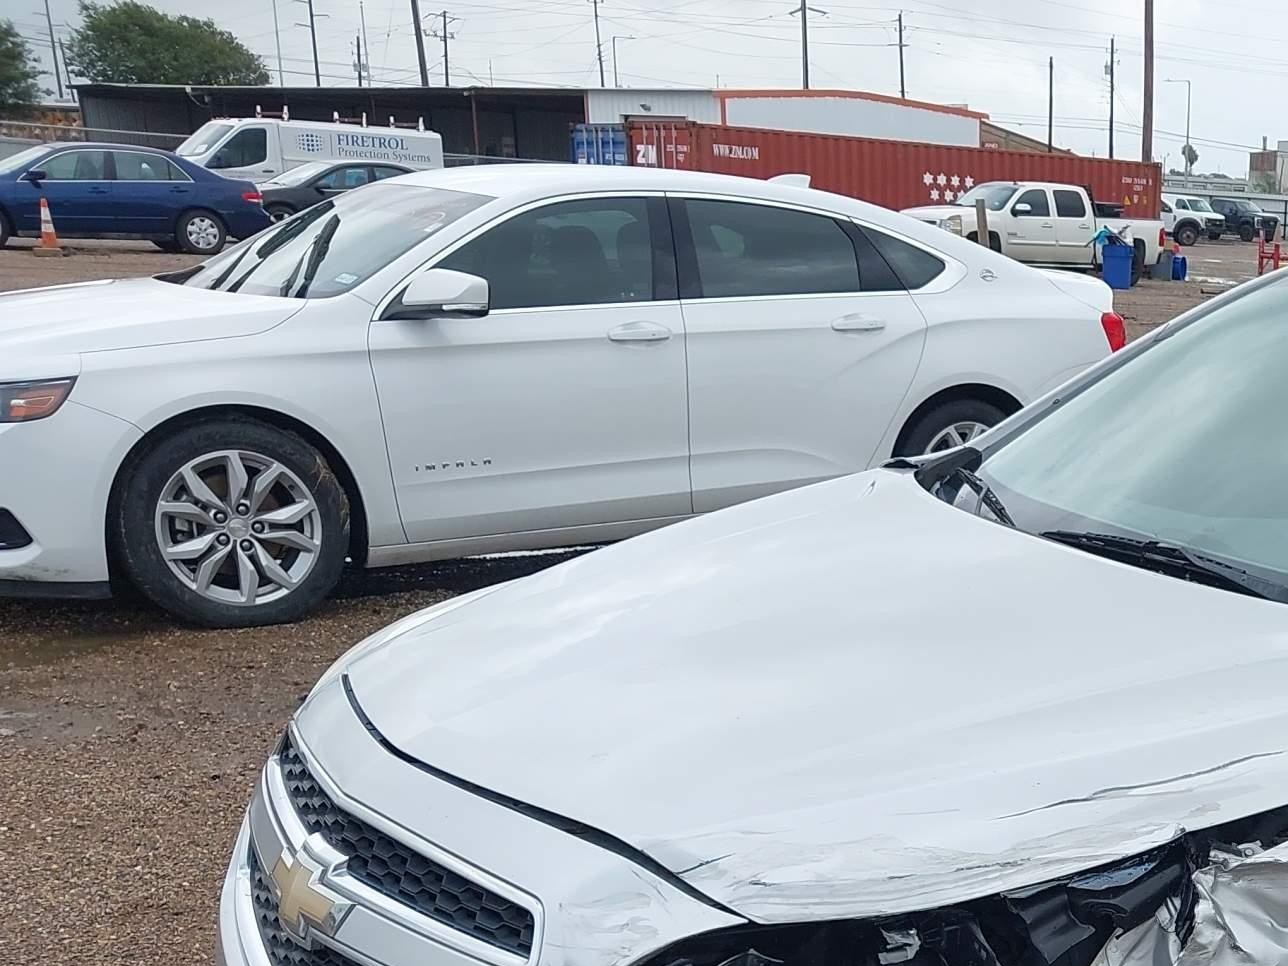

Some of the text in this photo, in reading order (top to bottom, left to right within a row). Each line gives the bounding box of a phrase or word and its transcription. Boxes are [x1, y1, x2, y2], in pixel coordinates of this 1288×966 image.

[336, 134, 409, 150] FIRETROL
[338, 147, 431, 163] Protection Systems
[415, 459, 492, 472] IMPALA
